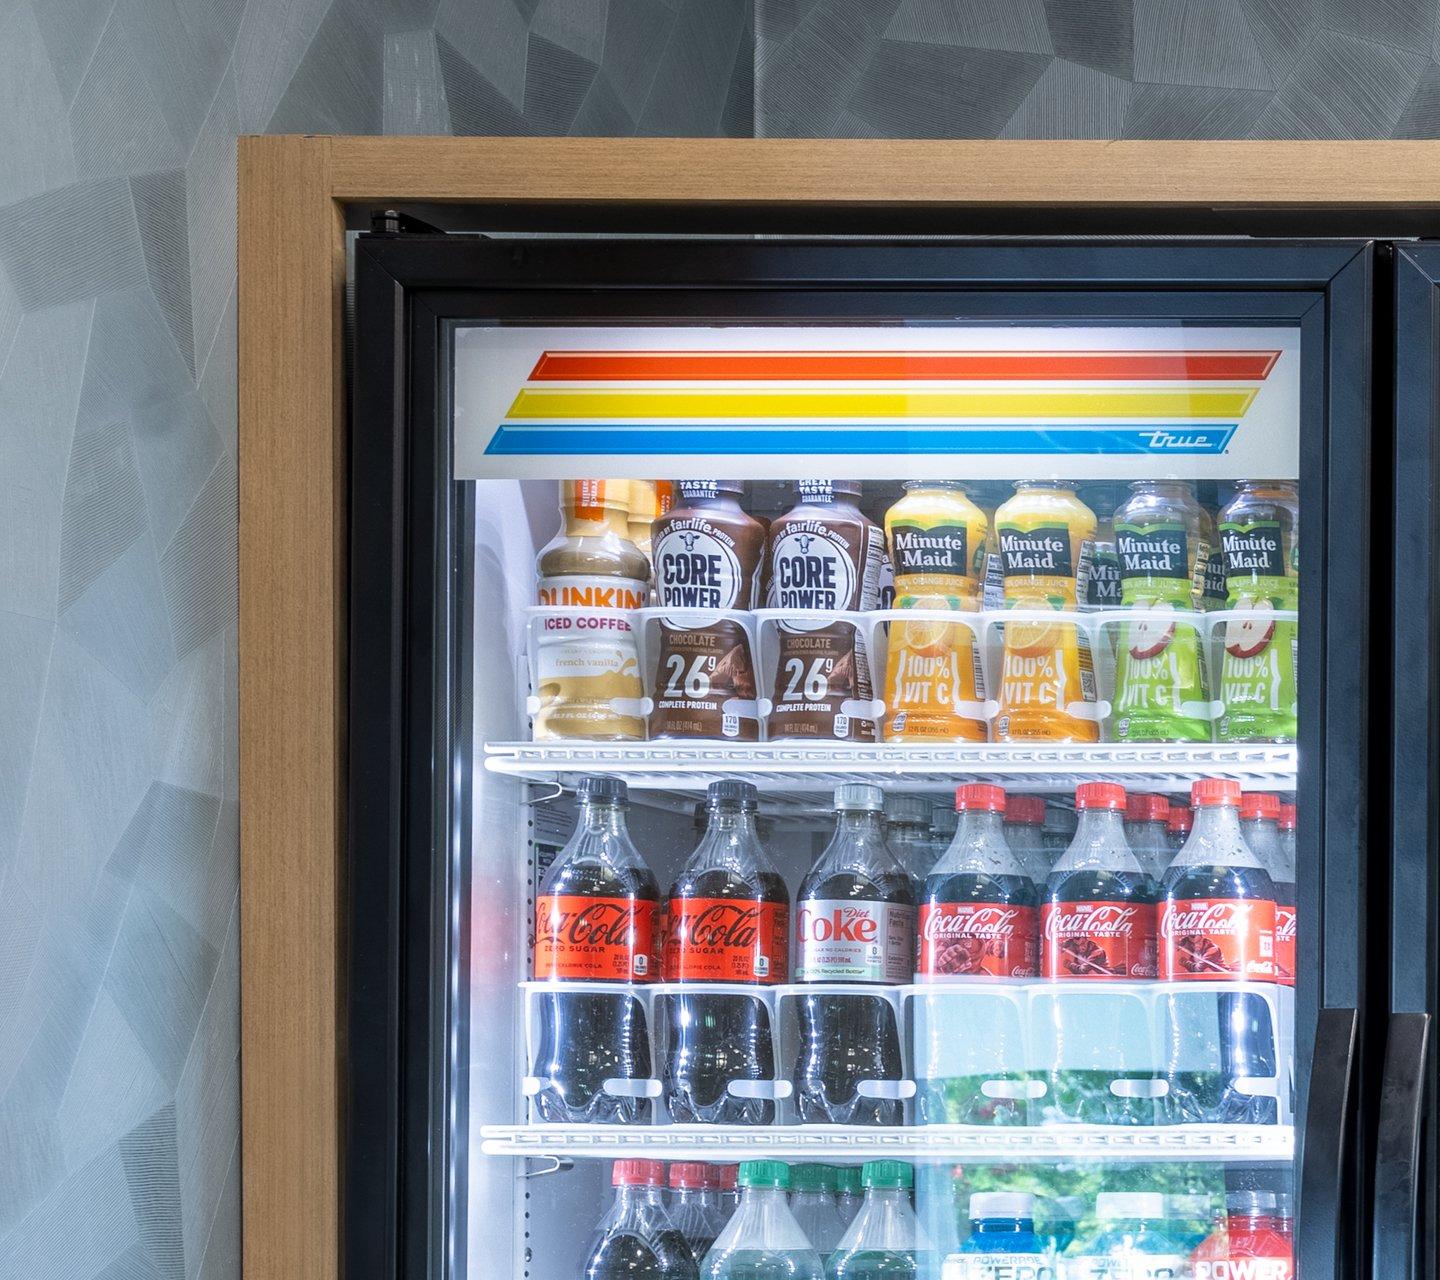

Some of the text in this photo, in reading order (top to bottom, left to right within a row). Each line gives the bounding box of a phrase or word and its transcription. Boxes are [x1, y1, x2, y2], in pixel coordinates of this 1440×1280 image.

[1139, 431, 1213, 448] true
[896, 532, 962, 551] Minute
[1001, 532, 1063, 553] Minute
[1119, 535, 1180, 555] Minute
[1223, 534, 1276, 553] Minute
[903, 550, 954, 568] Maid
[1008, 551, 1056, 570] Maid
[1125, 553, 1172, 571] Maid
[1228, 550, 1271, 568] Maid
[662, 554, 722, 587] CORE
[779, 557, 837, 589] CORE
[664, 587, 721, 609] POWER
[669, 633, 716, 646] CHOCOLATE
[787, 636, 831, 649] CHOCOLATE
[907, 655, 949, 677] 100%
[658, 700, 717, 710] COMPLETE PROTEIN
